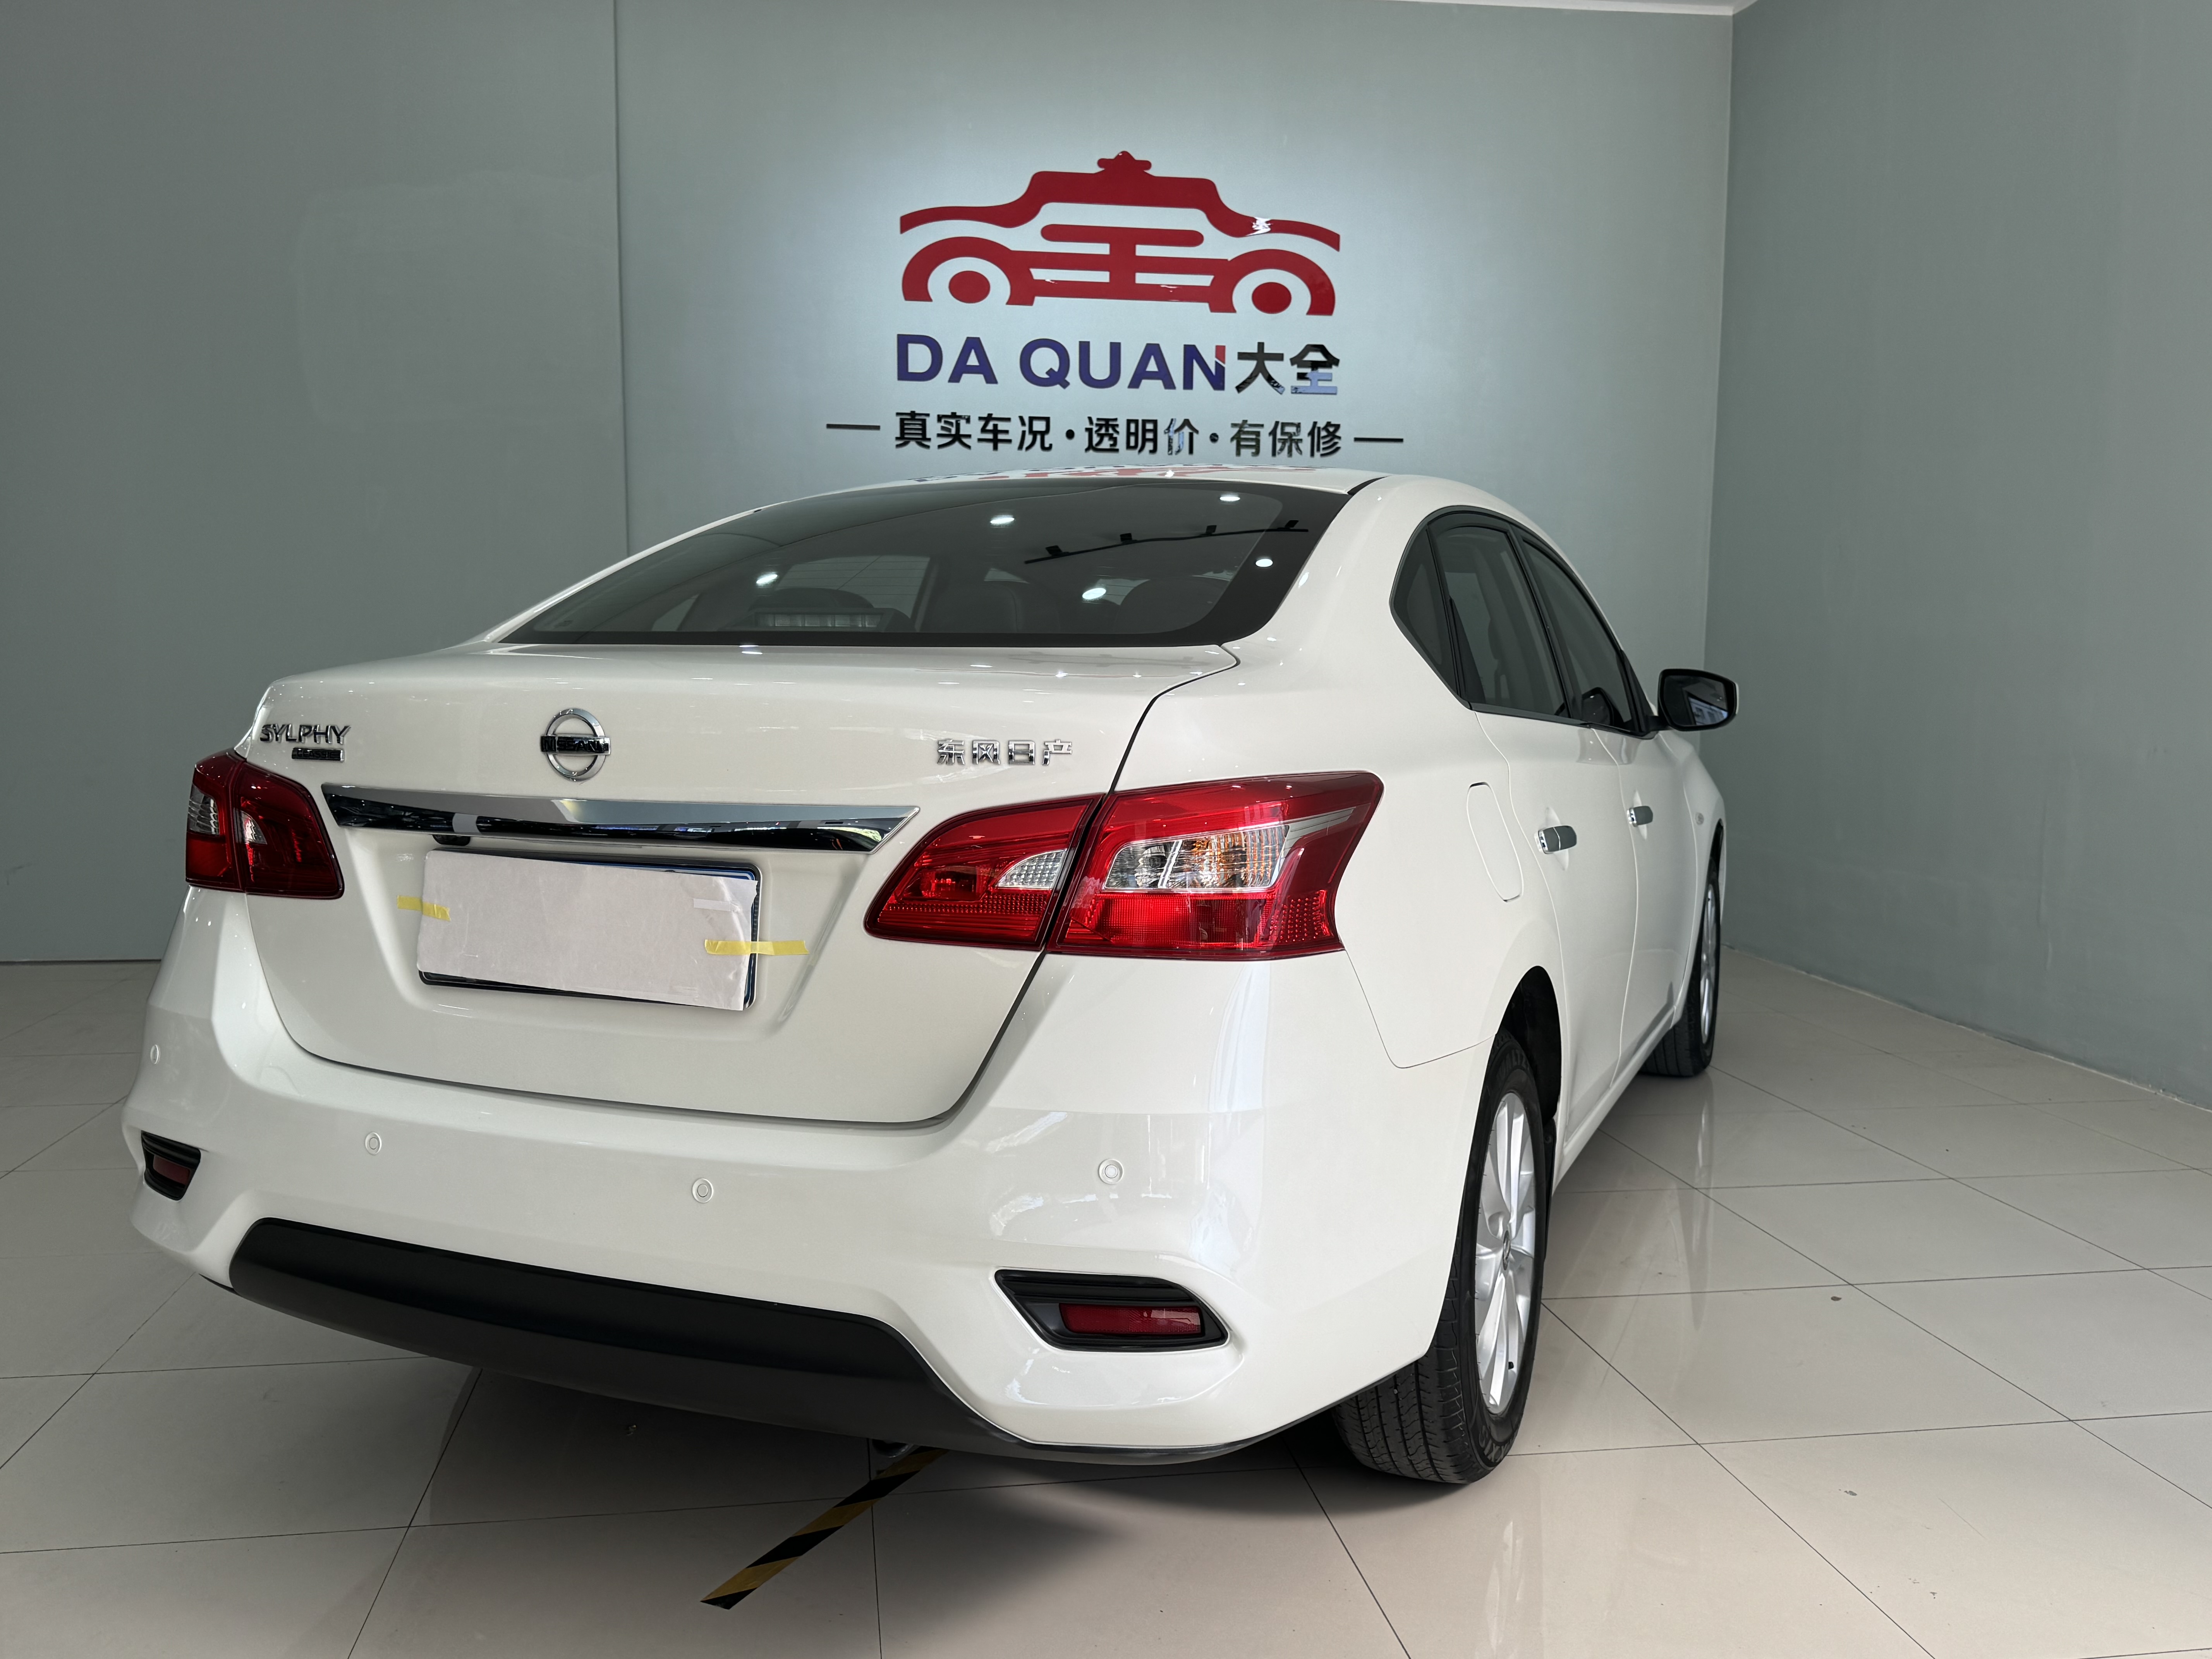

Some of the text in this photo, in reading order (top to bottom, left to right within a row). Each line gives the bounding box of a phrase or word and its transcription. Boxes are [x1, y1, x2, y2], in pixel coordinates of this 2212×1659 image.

[896, 334, 998, 384] DA
[260, 723, 352, 744] SYLPHY
[543, 738, 601, 752] NISSAN
[937, 739, 1072, 766] 东风日产
